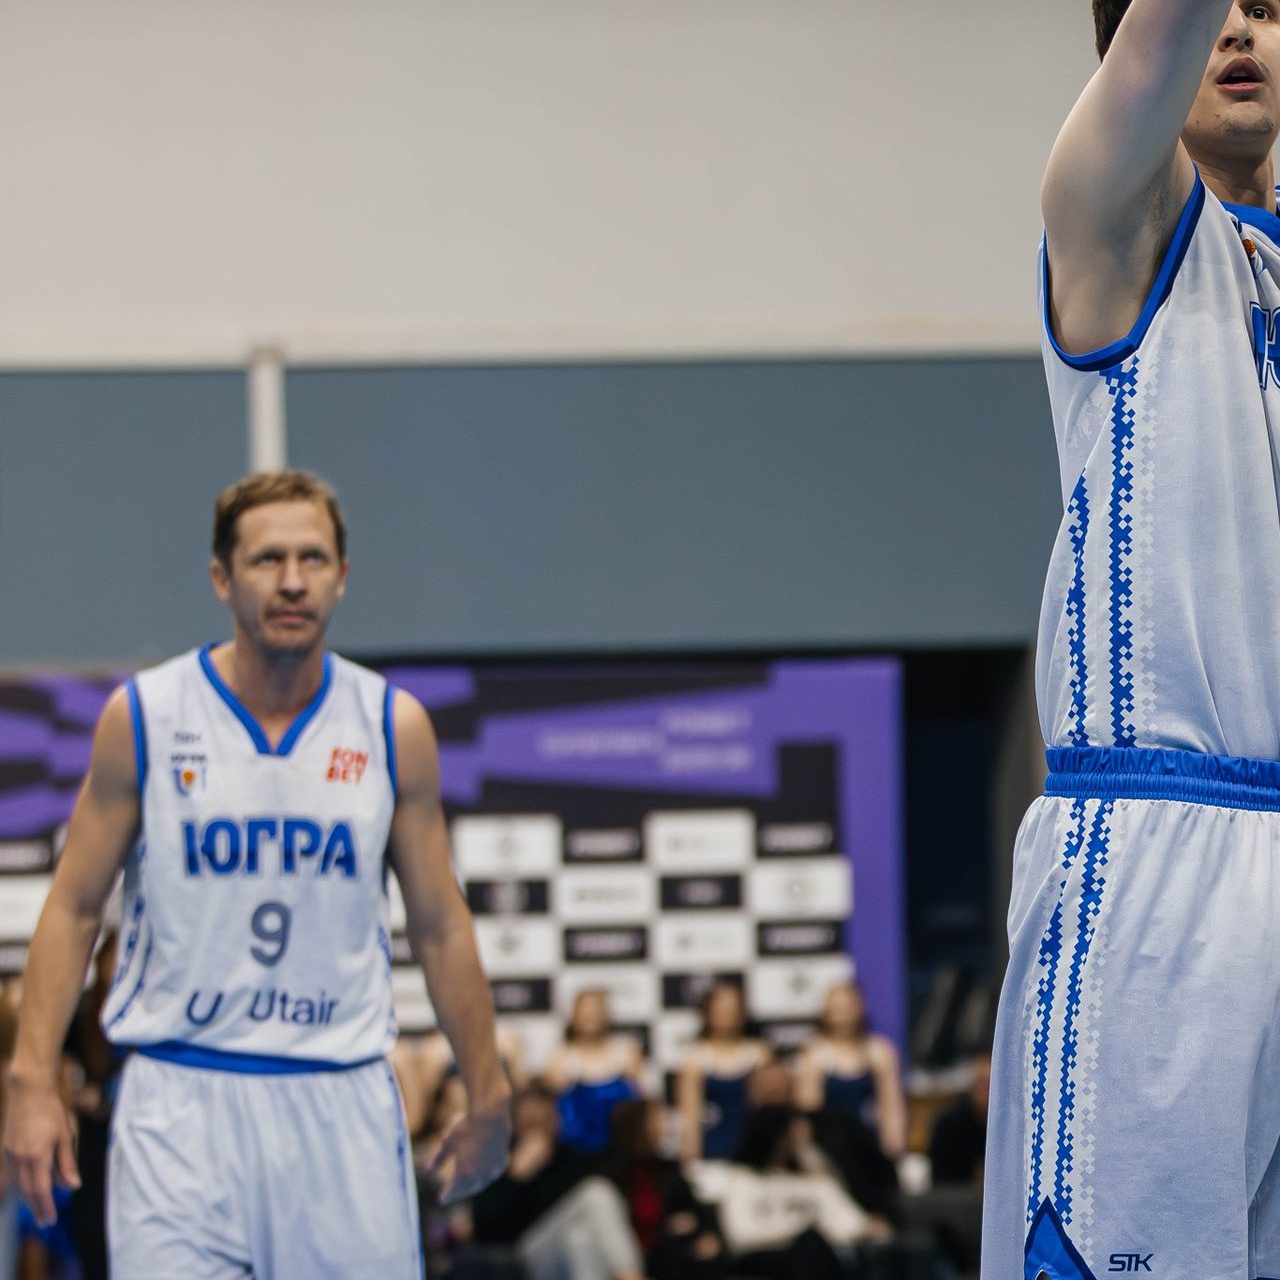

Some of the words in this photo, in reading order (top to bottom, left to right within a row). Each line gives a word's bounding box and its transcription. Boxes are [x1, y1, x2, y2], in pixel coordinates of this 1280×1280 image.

[181, 815, 359, 878] ЮГРА
[250, 899, 293, 968] 9
[248, 986, 340, 1026] Utair
[1107, 1253, 1155, 1272] STK
